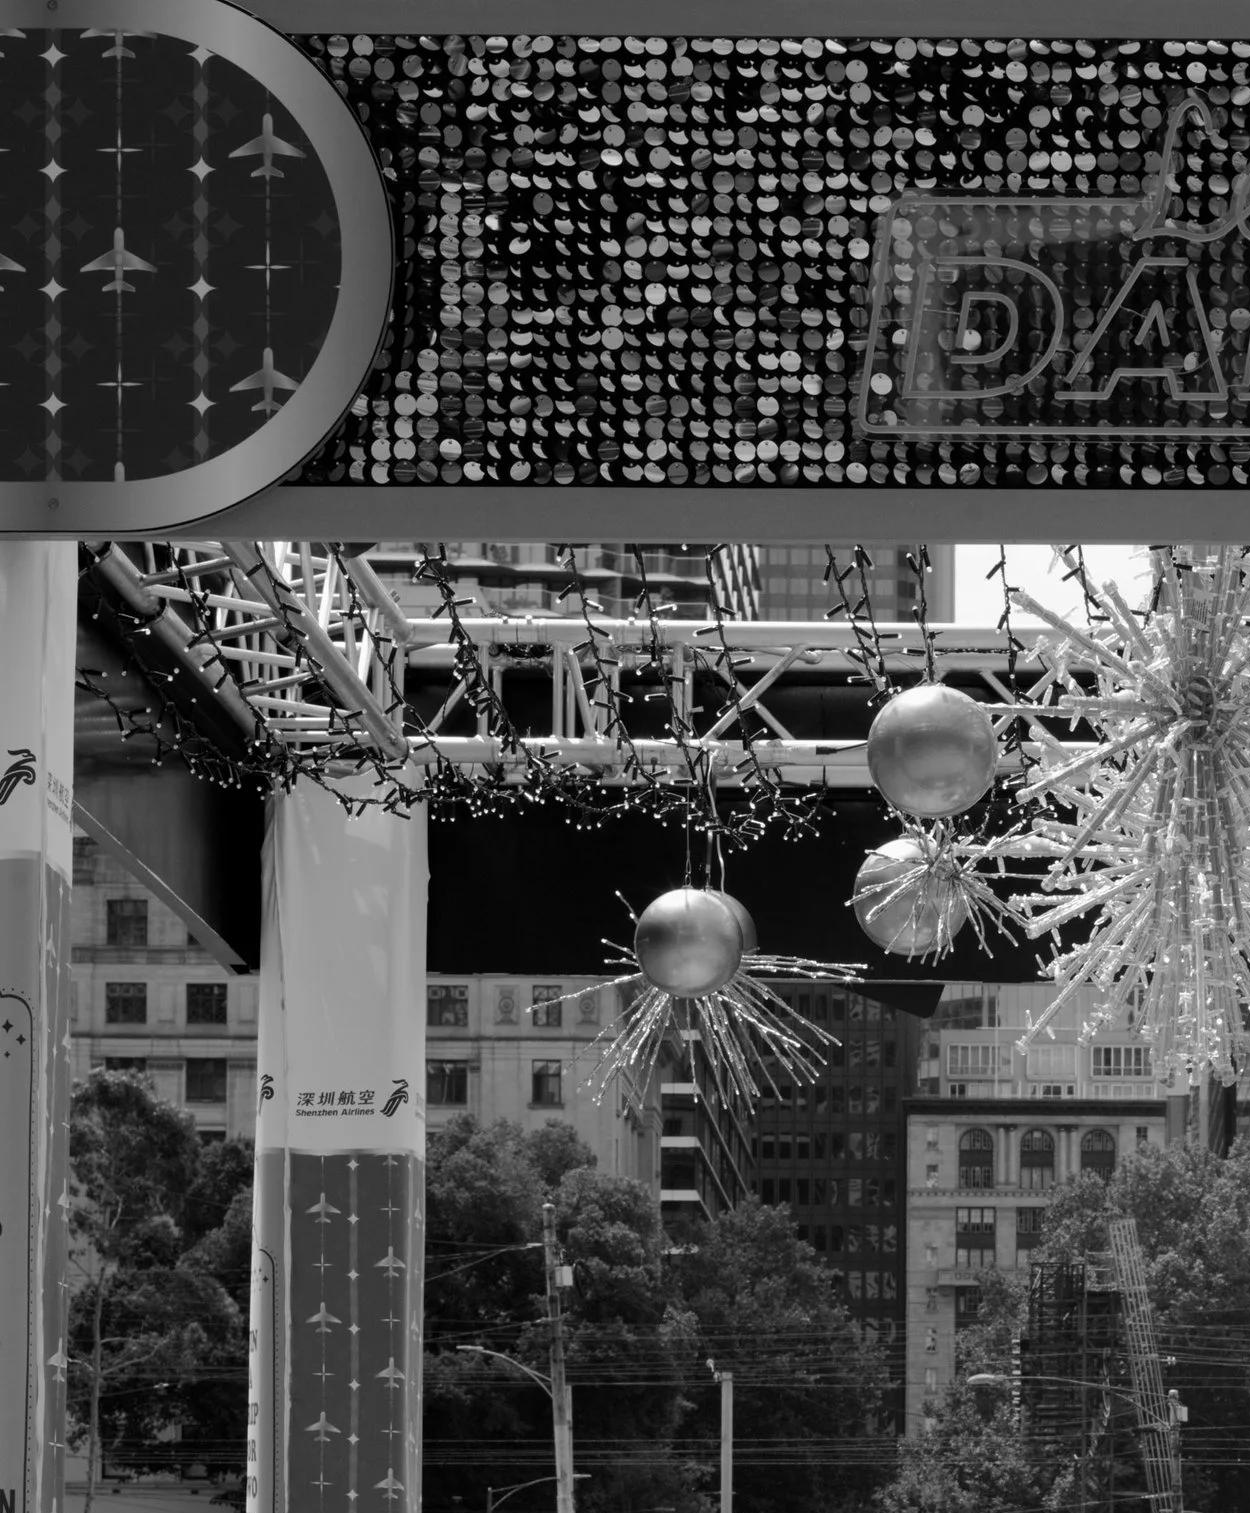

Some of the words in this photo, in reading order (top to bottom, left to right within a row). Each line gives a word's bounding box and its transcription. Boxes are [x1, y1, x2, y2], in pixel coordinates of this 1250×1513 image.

[297, 1090, 375, 1106] 深圳航空
[295, 1108, 339, 1116] Shenzhen
[341, 1107, 375, 1116] Airlines
